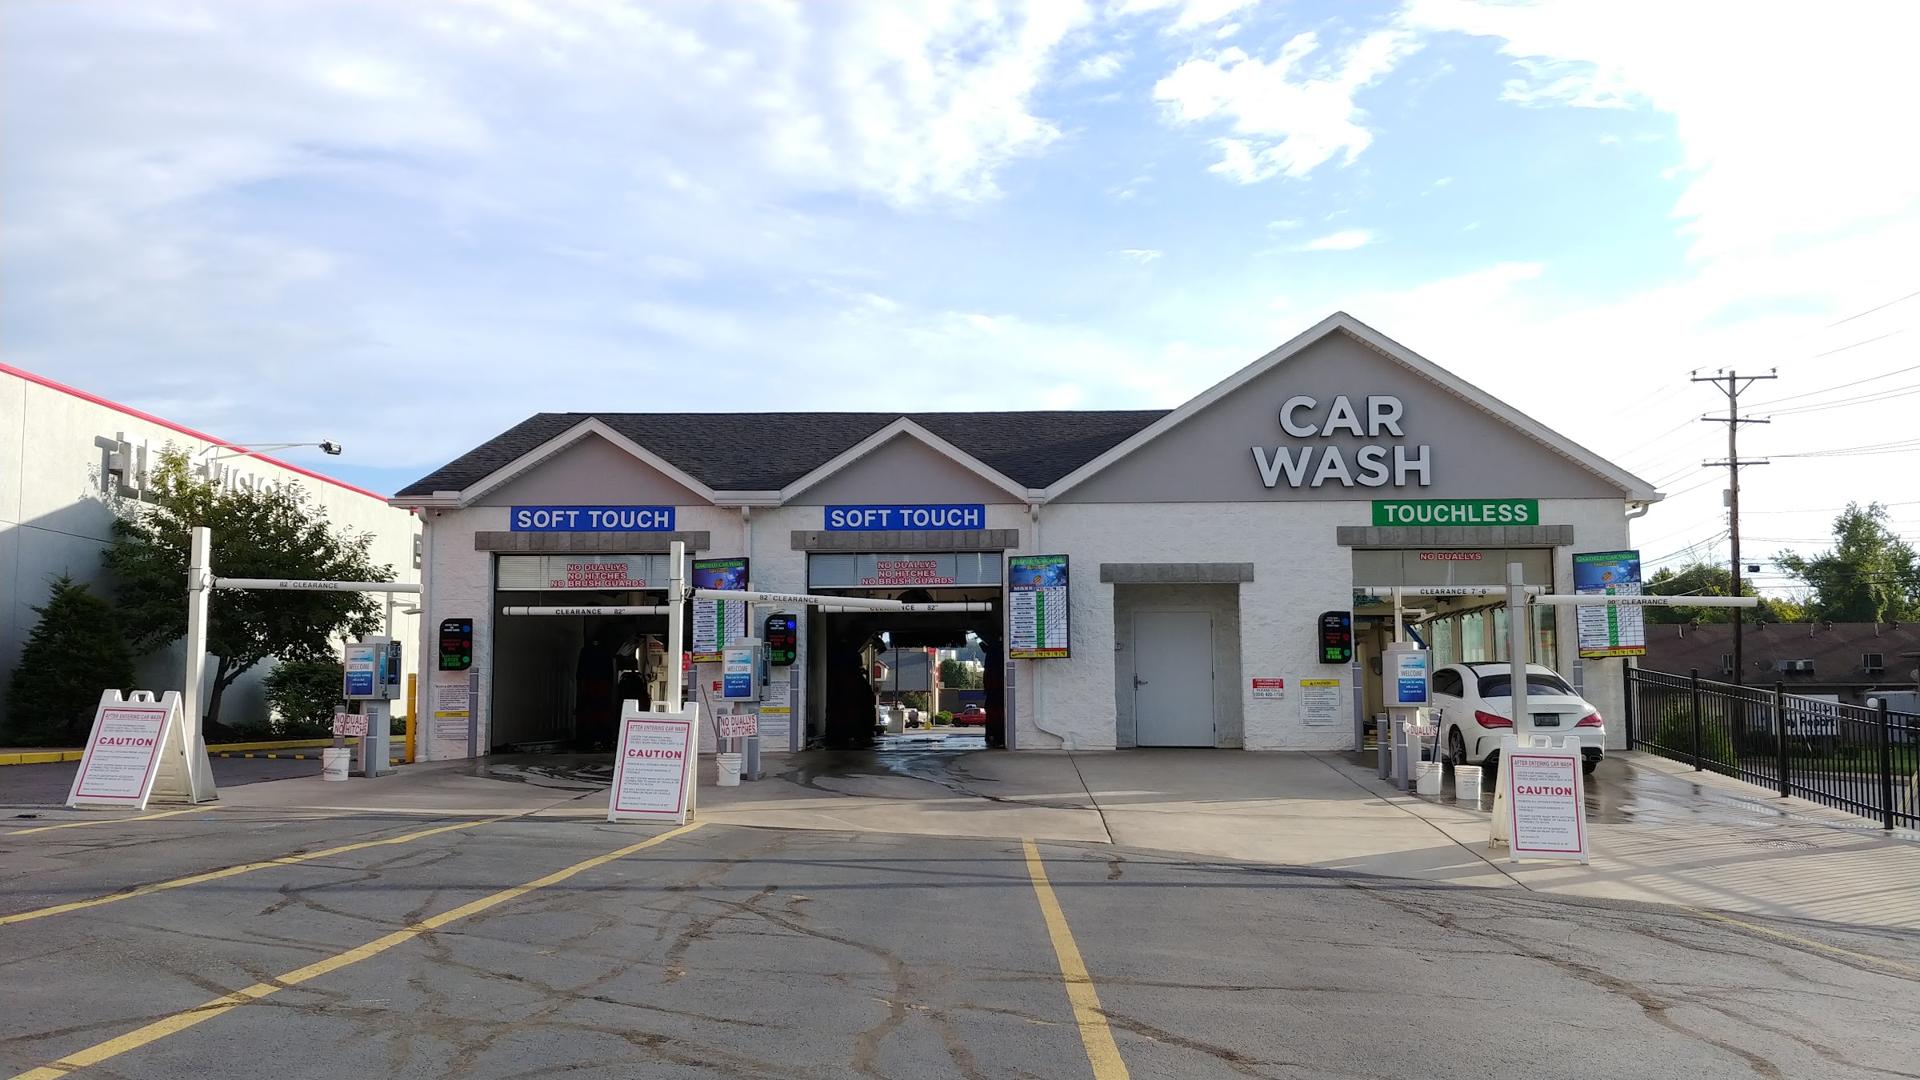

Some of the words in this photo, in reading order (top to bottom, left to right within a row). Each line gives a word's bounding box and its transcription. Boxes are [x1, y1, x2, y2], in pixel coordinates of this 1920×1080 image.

[1279, 395, 1404, 437] CAR
[1251, 445, 1431, 488] WASH
[831, 509, 891, 527] SOFT
[900, 508, 979, 526] TOUCH
[1384, 504, 1530, 522] TOUCHLESS
[518, 510, 579, 528] SOFT
[588, 510, 669, 528] TOUCH
[1438, 552, 1482, 560] DUALLYS
[584, 563, 628, 571] DUALLYS
[877, 561, 891, 569] NO
[894, 560, 936, 569] DUALLYS
[895, 569, 936, 577] HITCHES
[914, 577, 954, 585] GUARDS
[772, 595, 819, 603] CLEARANCE
[335, 714, 344, 723] NO
[720, 717, 729, 726] NO
[731, 715, 756, 726] DUALLYS
[334, 725, 344, 733] NO
[721, 728, 730, 736] NO
[732, 725, 756, 735] HITCHES
[100, 737, 154, 746] CAUTION
[628, 749, 682, 759] CAUTION
[1517, 785, 1572, 795] CAUTION
